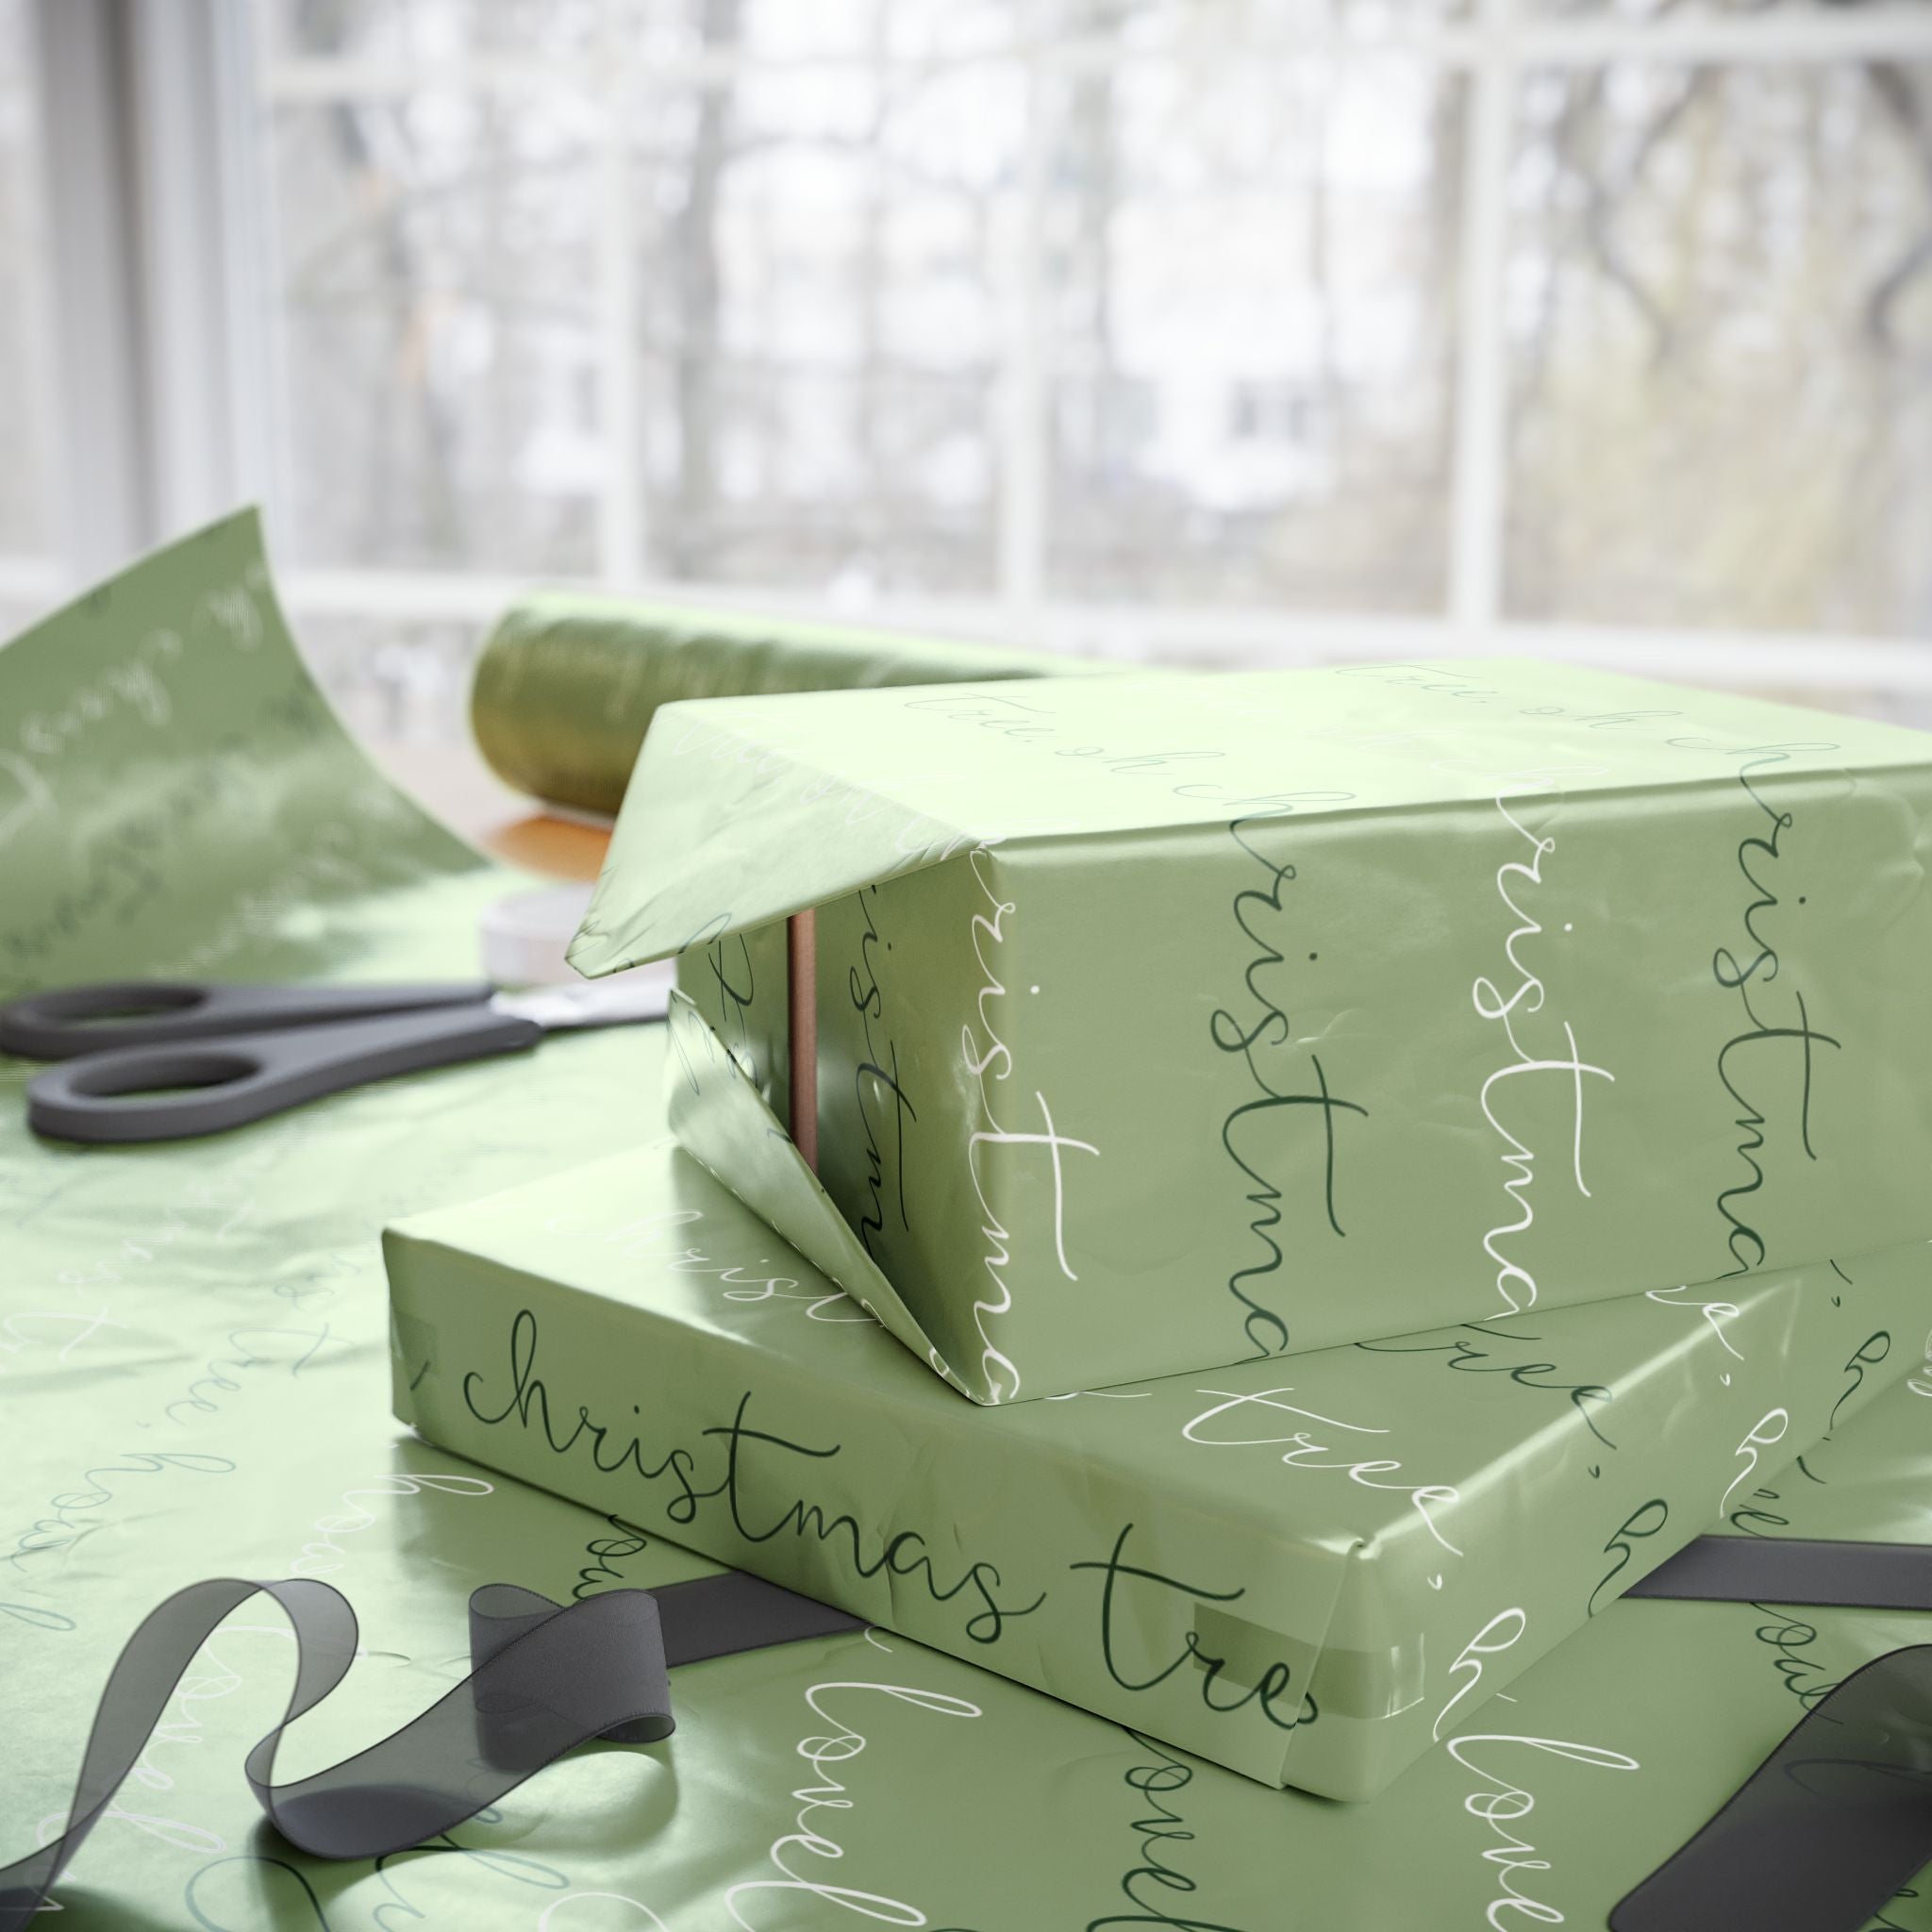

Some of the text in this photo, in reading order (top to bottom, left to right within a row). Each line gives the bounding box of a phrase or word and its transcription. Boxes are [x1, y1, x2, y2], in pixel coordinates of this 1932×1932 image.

[1171, 782, 1369, 1366] christma
[1428, 758, 1616, 1323] christma
[1664, 737, 1842, 1281] christma
[462, 1308, 1047, 1645] christmas
